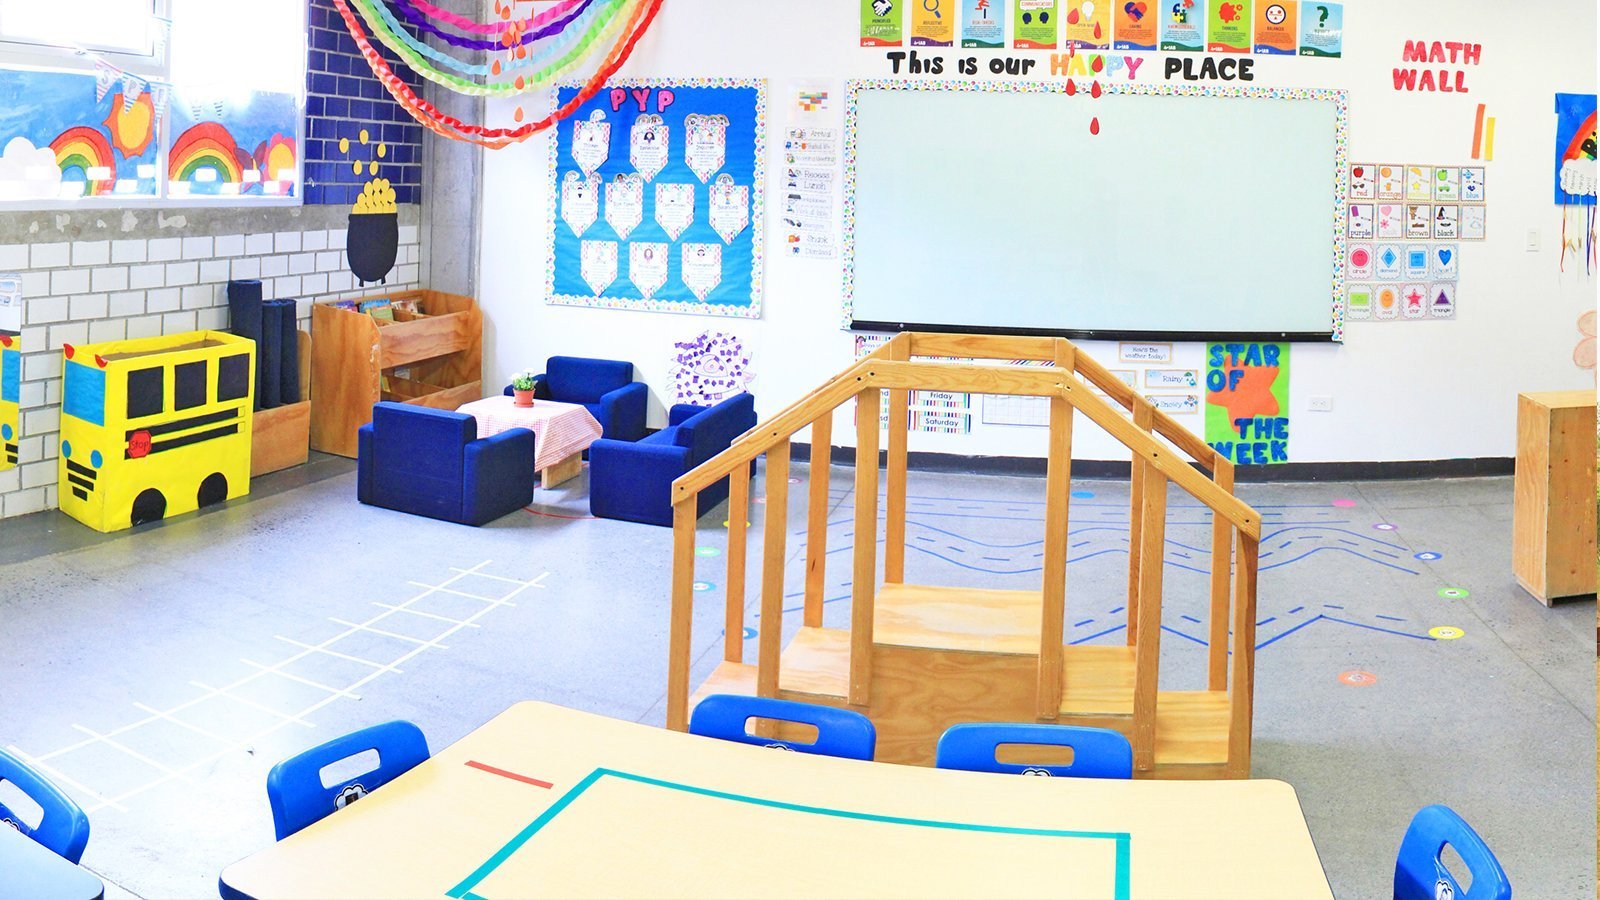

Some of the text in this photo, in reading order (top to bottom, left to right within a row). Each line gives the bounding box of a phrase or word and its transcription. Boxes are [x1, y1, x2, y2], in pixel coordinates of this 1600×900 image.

[1402, 40, 1482, 66] MATH
[886, 50, 1255, 81] This is our HAPPY PLACE
[1392, 68, 1469, 93] WALL
[1379, 192, 1401, 200] orange
[1350, 229, 1371, 238] purple
[1209, 343, 1280, 367] STAR
[1206, 369, 1245, 392] OF
[930, 392, 953, 400] Friday
[1160, 400, 1182, 408] Snowy
[925, 418, 959, 426] Saturday
[1234, 417, 1289, 440] THE
[131, 440, 148, 451] Stop
[1206, 440, 1288, 465] WEEK
